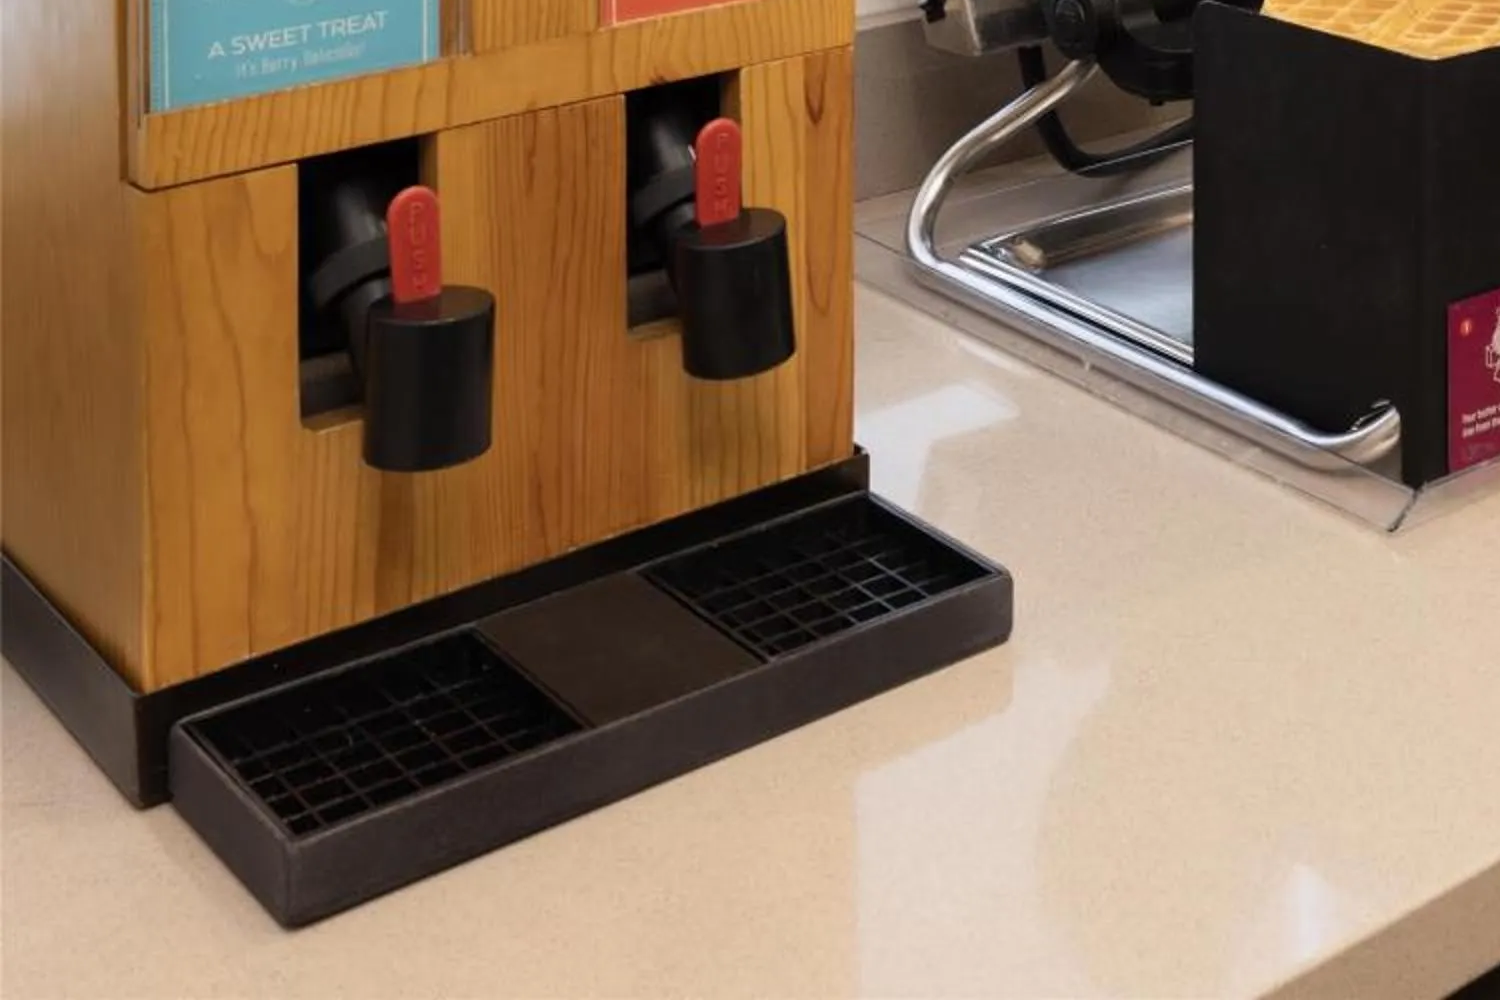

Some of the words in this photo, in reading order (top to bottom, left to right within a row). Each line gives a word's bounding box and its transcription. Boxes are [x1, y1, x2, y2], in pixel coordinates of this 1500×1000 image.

[207, 41, 227, 60] A
[231, 24, 312, 55] SWEET
[317, 10, 388, 39] TREAT
